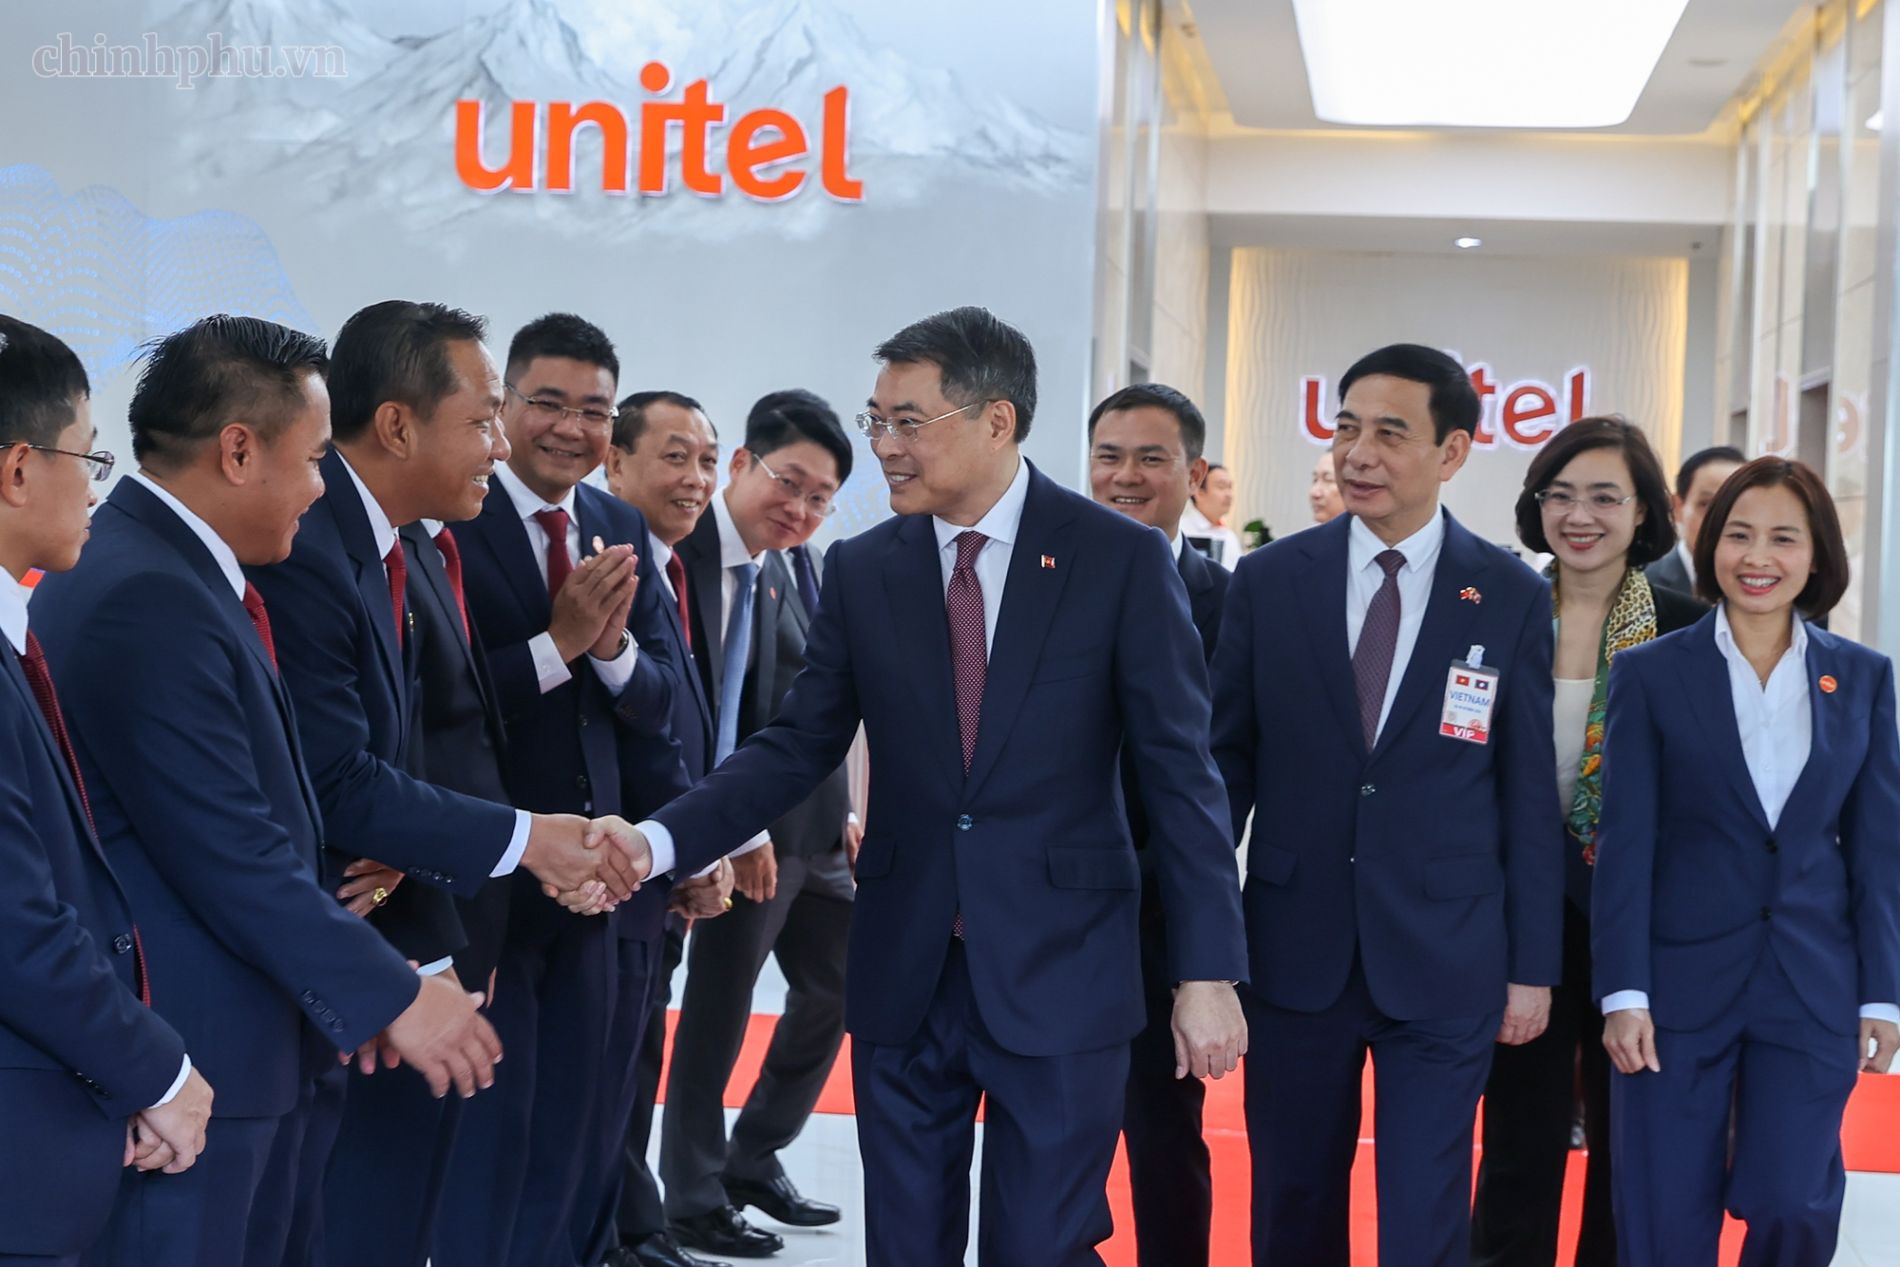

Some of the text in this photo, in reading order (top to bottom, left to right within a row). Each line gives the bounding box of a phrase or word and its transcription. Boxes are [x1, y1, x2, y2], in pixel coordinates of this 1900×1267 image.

[454, 61, 864, 202] unitel
[1303, 364, 1587, 446] utel
[1449, 690, 1491, 706] VIETNAM
[1453, 726, 1476, 738] VIP
